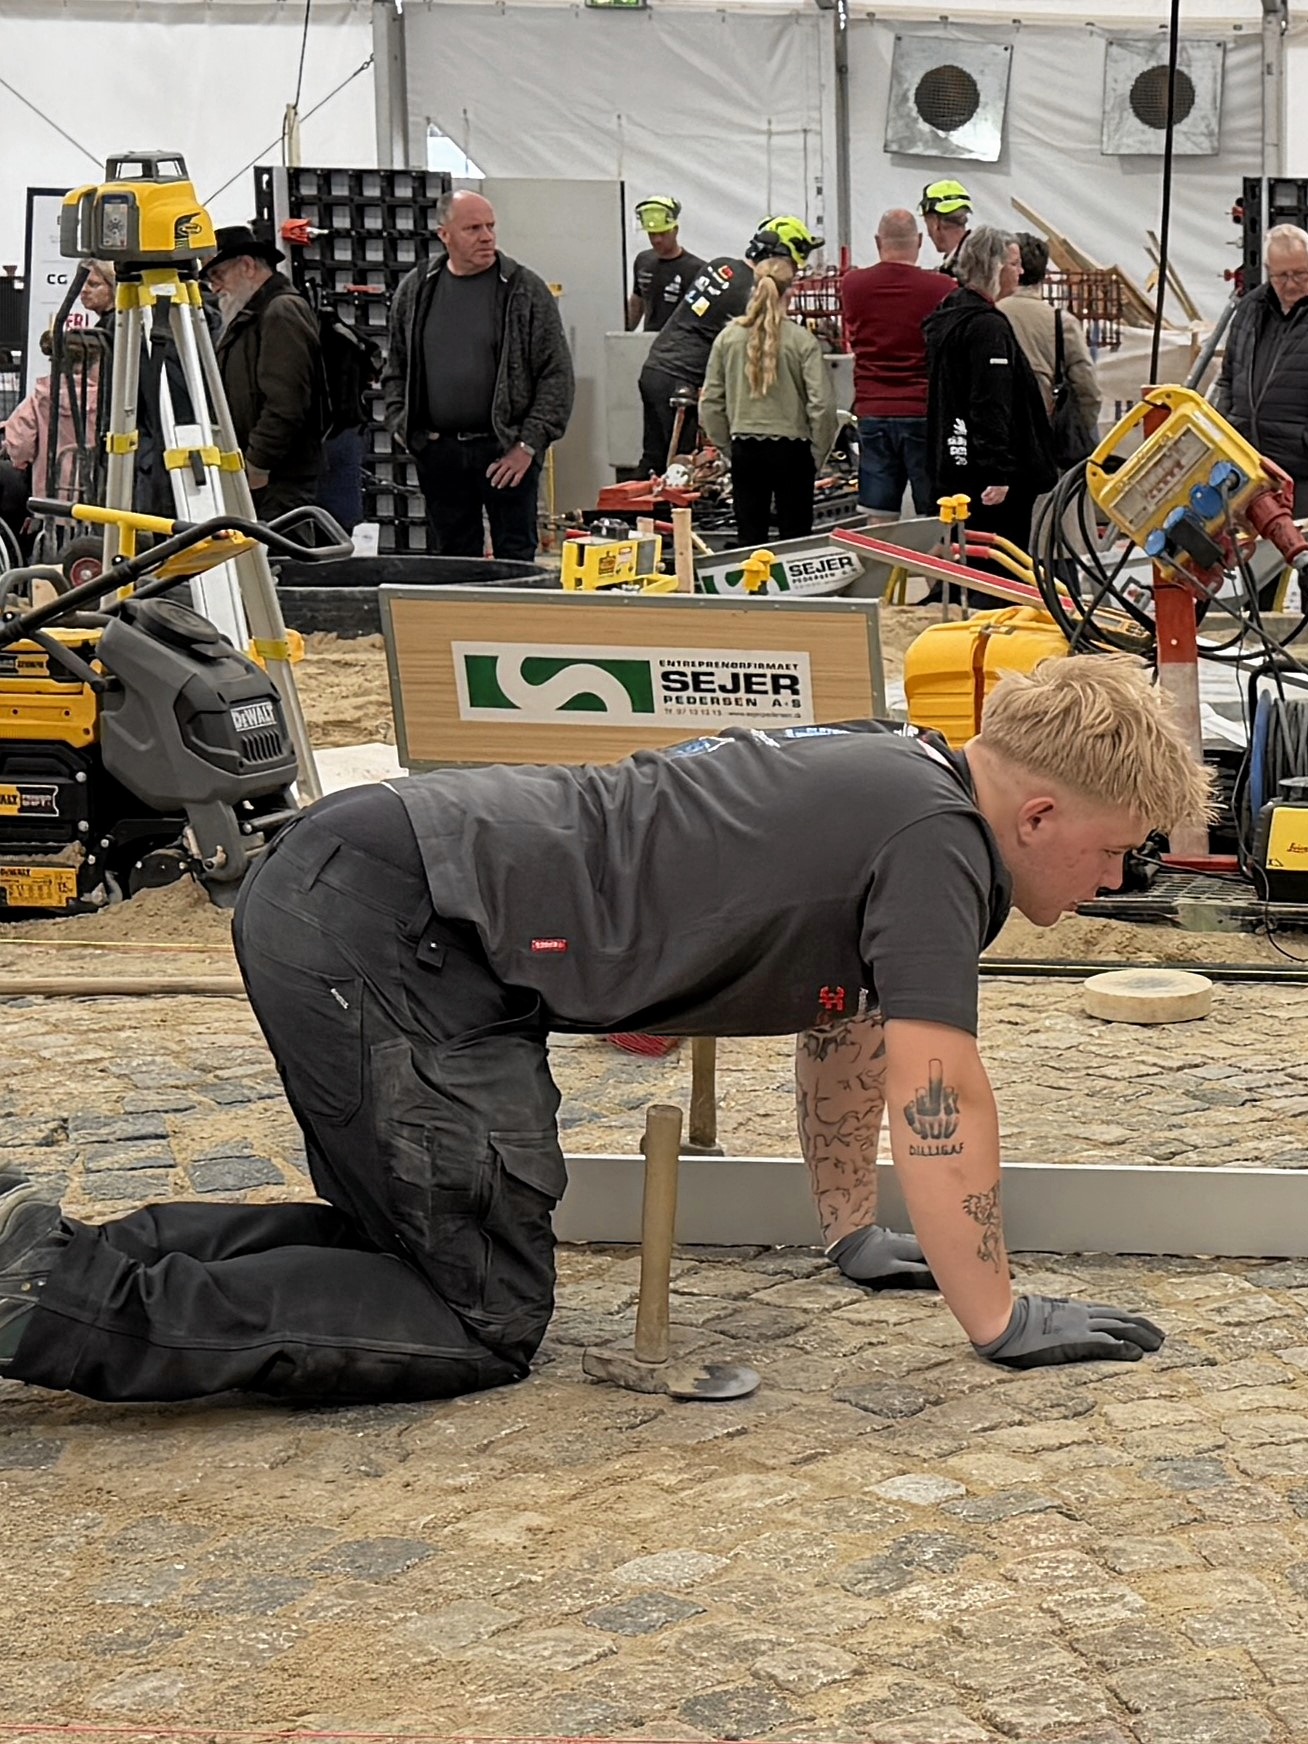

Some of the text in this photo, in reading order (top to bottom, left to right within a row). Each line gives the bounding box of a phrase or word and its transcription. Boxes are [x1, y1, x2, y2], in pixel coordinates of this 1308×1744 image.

[789, 556, 855, 578] SEJER
[660, 670, 801, 696] SEJER
[663, 695, 758, 707] PEDERSEN
[909, 1142, 964, 1157] DILLIGAF
